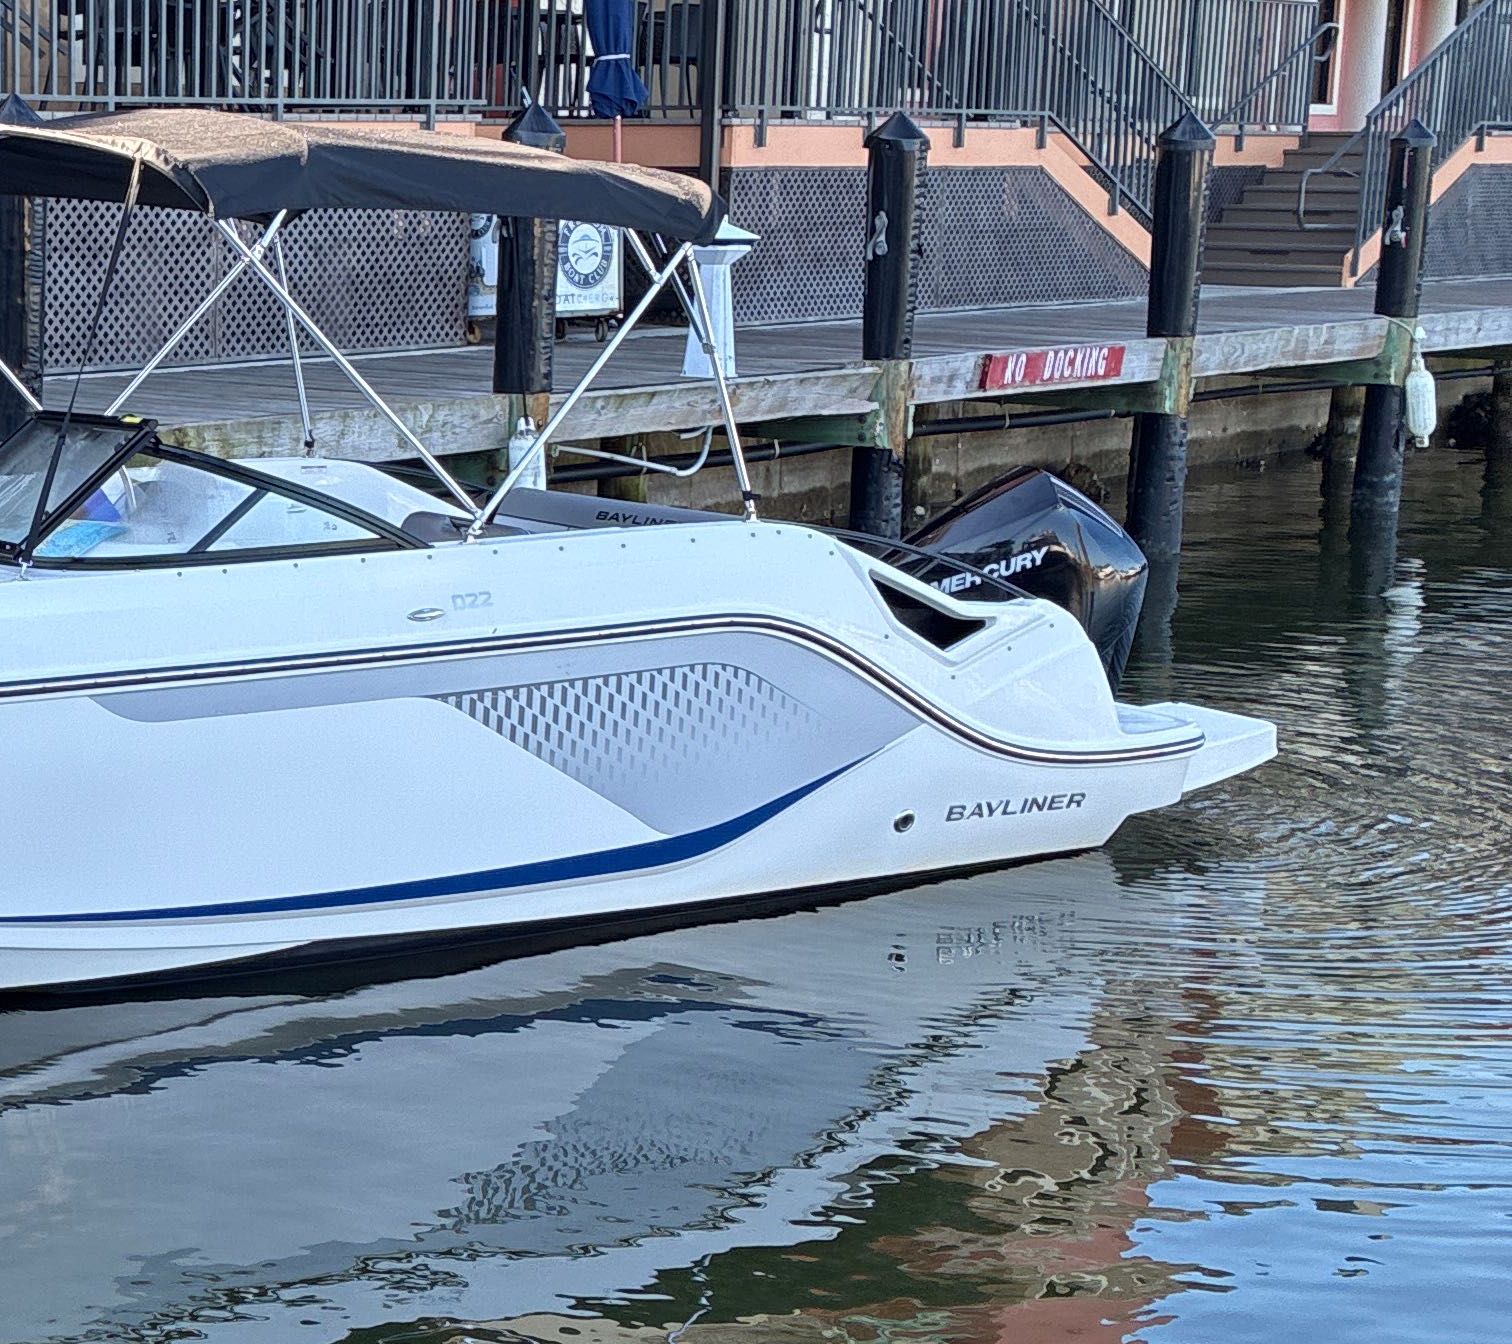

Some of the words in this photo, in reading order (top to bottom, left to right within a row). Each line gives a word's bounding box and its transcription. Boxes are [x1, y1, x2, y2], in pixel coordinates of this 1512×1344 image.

[563, 261, 586, 285] BOAT
[588, 259, 608, 284] CLUB
[1003, 353, 1027, 385] NO
[1042, 346, 1109, 381] DOCKING
[944, 791, 1087, 823] BAYLINER
